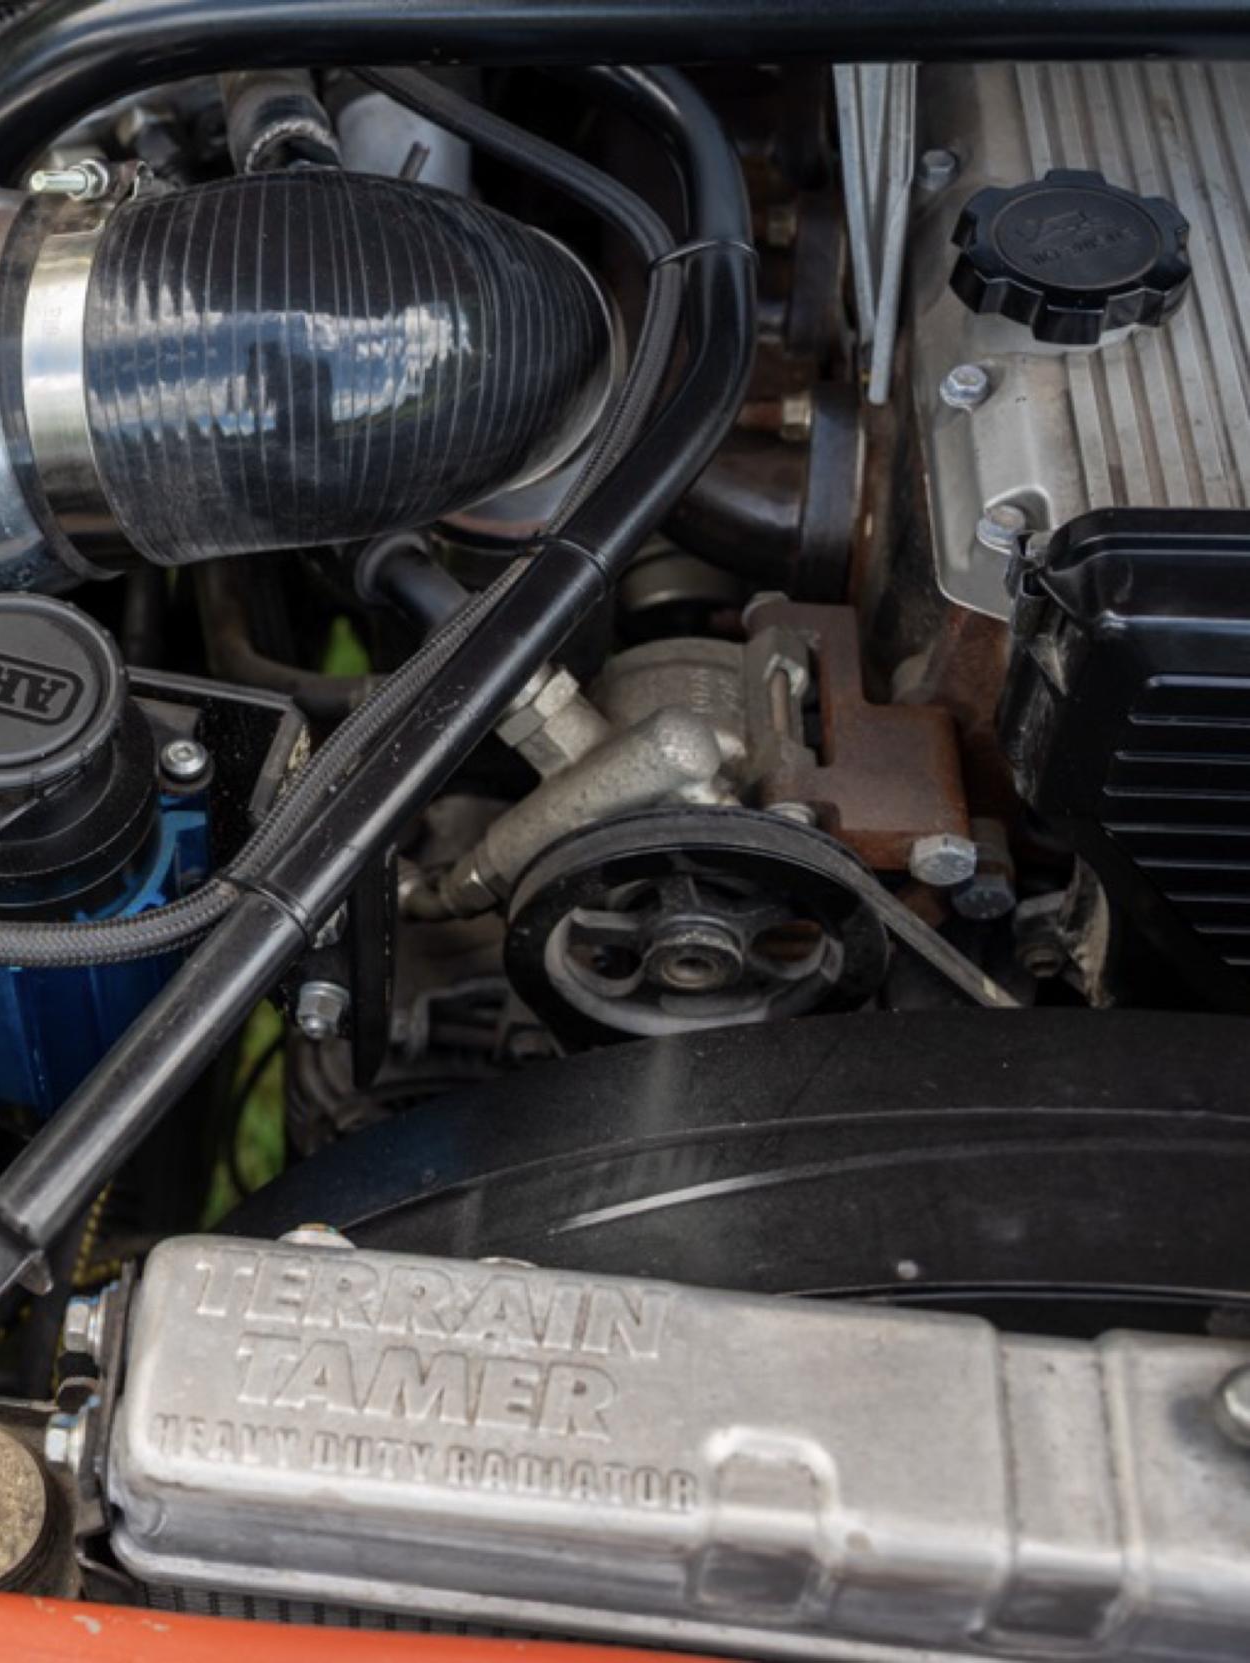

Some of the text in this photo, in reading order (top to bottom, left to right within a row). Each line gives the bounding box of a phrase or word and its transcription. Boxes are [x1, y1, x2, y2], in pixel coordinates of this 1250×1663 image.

[196, 1250, 667, 1360] TERRAIN
[236, 1332, 619, 1441] TAMER
[155, 1413, 701, 1513] HEAVY DUTY RADIATOR
